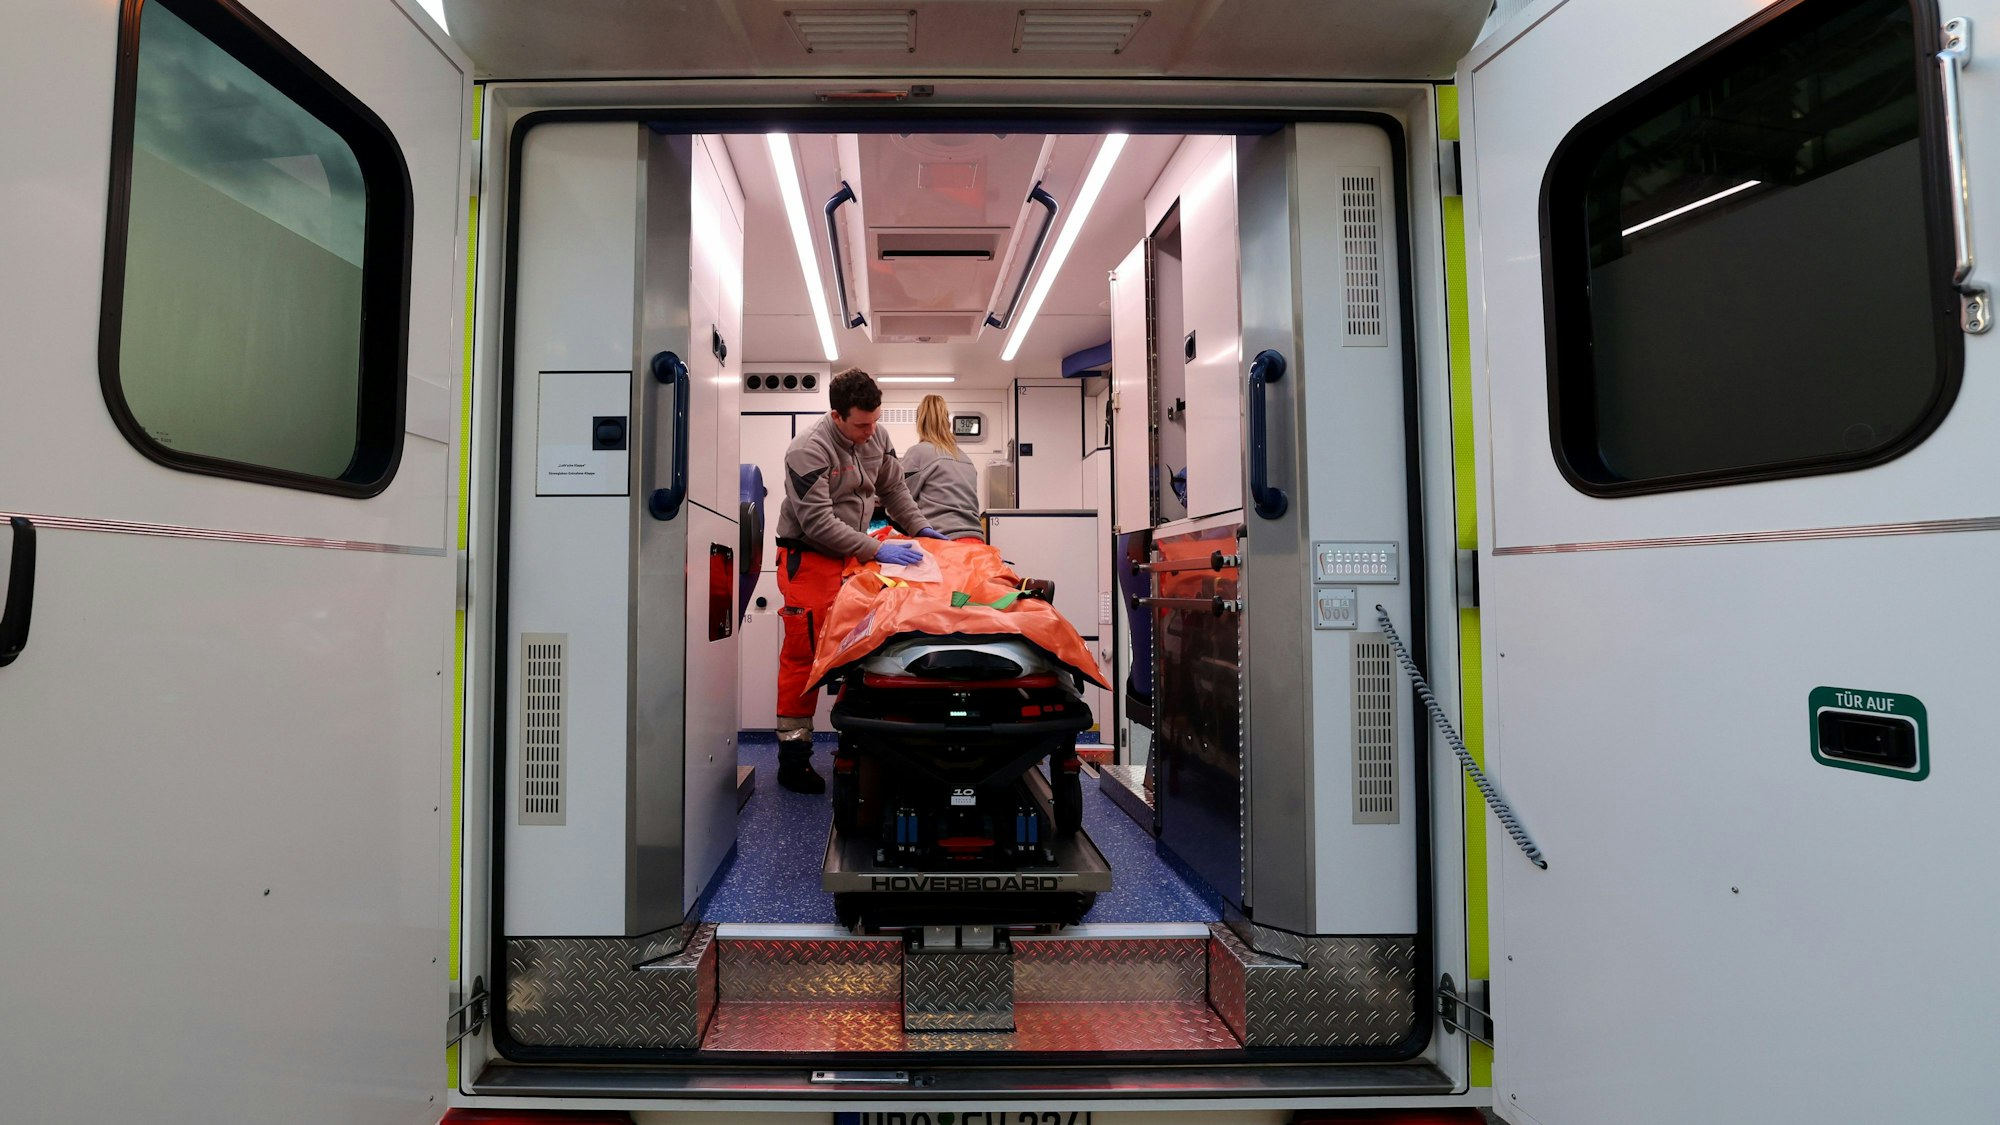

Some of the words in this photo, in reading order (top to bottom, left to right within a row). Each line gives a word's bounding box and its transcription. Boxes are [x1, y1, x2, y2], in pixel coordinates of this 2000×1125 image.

[1019, 386, 1028, 396] 12
[991, 517, 1000, 526] 13
[1835, 691, 1863, 709] TÜR
[1867, 696, 1895, 712] AUF
[953, 788, 975, 796] 10
